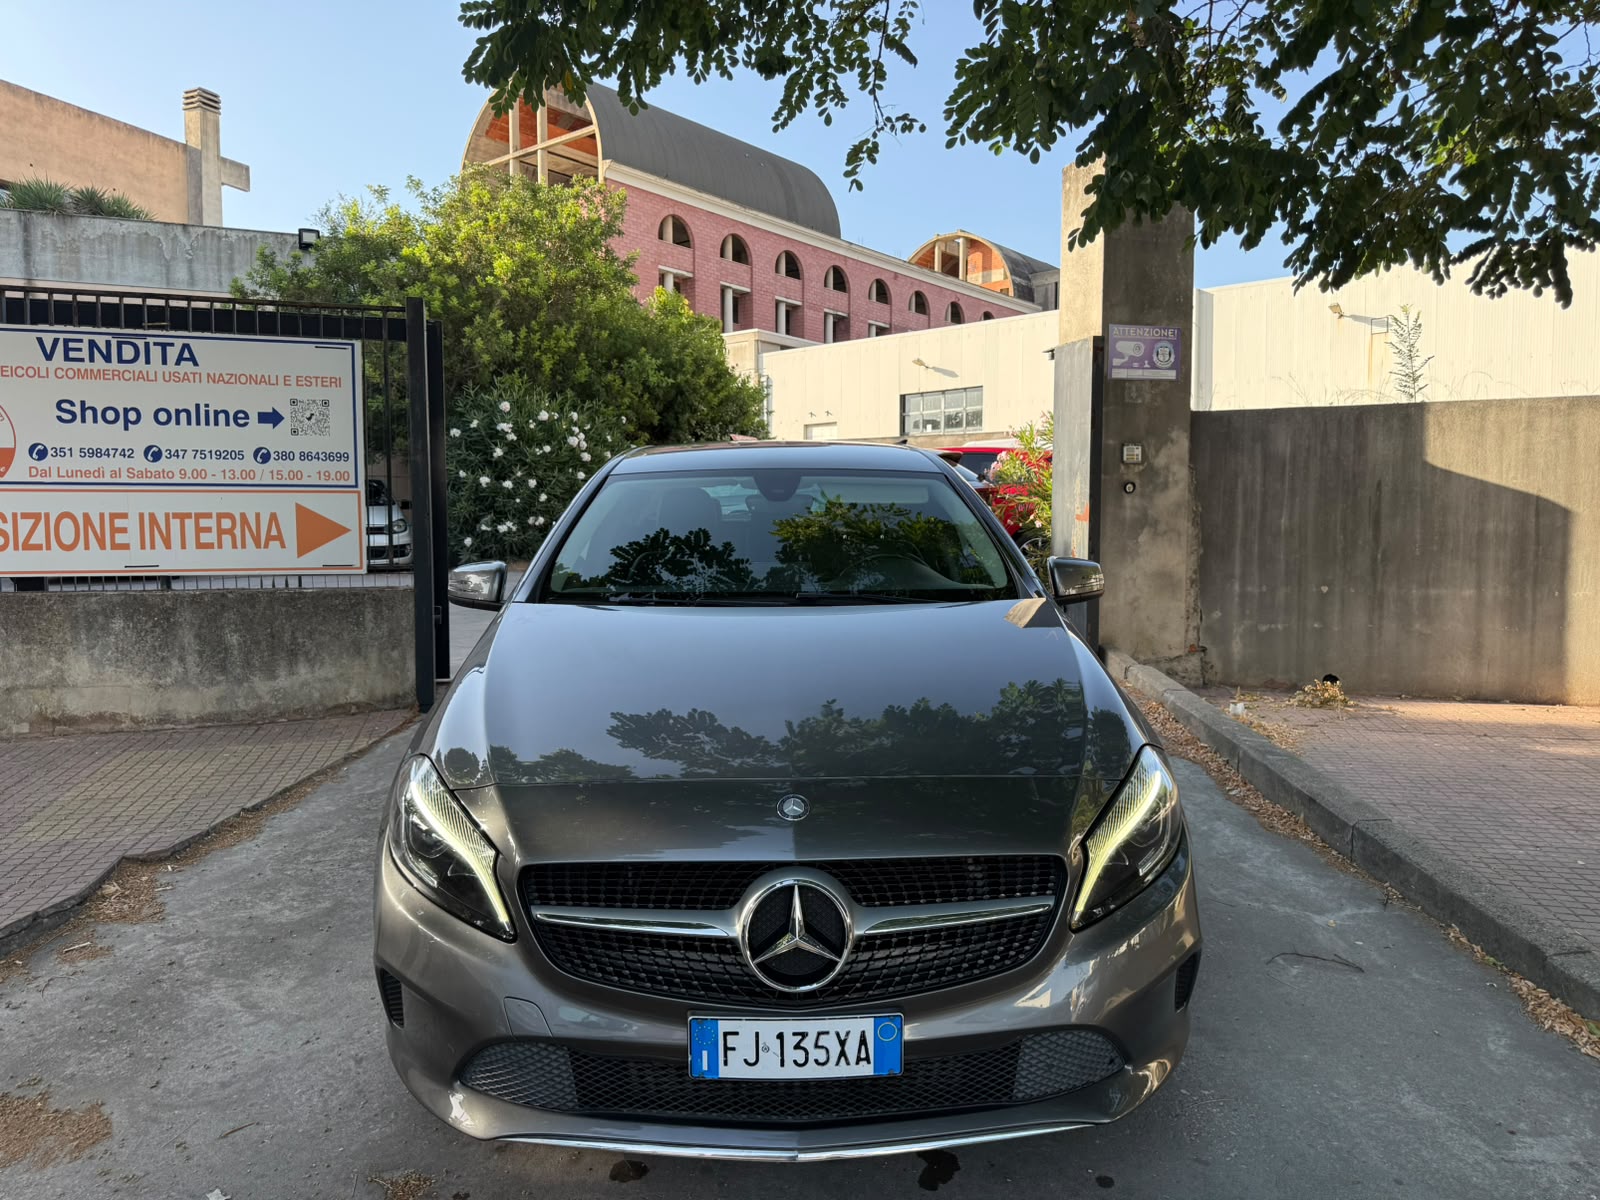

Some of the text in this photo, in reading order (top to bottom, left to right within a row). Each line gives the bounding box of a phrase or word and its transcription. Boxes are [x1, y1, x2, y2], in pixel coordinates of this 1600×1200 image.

[1113, 327, 1177, 337] ATTENZIONE!
[35, 336, 200, 367] VENDITA
[0, 365, 342, 388] EICOLI COMMERCIALI USATI NAZIONALI E ESTERI
[55, 398, 251, 431] Shop online
[50, 446, 350, 463] 351 5984742 347 7519205 380 8643699
[28, 465, 52, 478] Dal
[56, 466, 106, 480] Lunedì
[109, 467, 122, 479] al
[126, 468, 175, 480] Sabato
[178, 468, 208, 481] 9.00
[220, 469, 256, 481] 13.00
[269, 470, 304, 482] 15.00
[315, 470, 351, 482] 19.00
[138, 511, 287, 551] INTERNA
